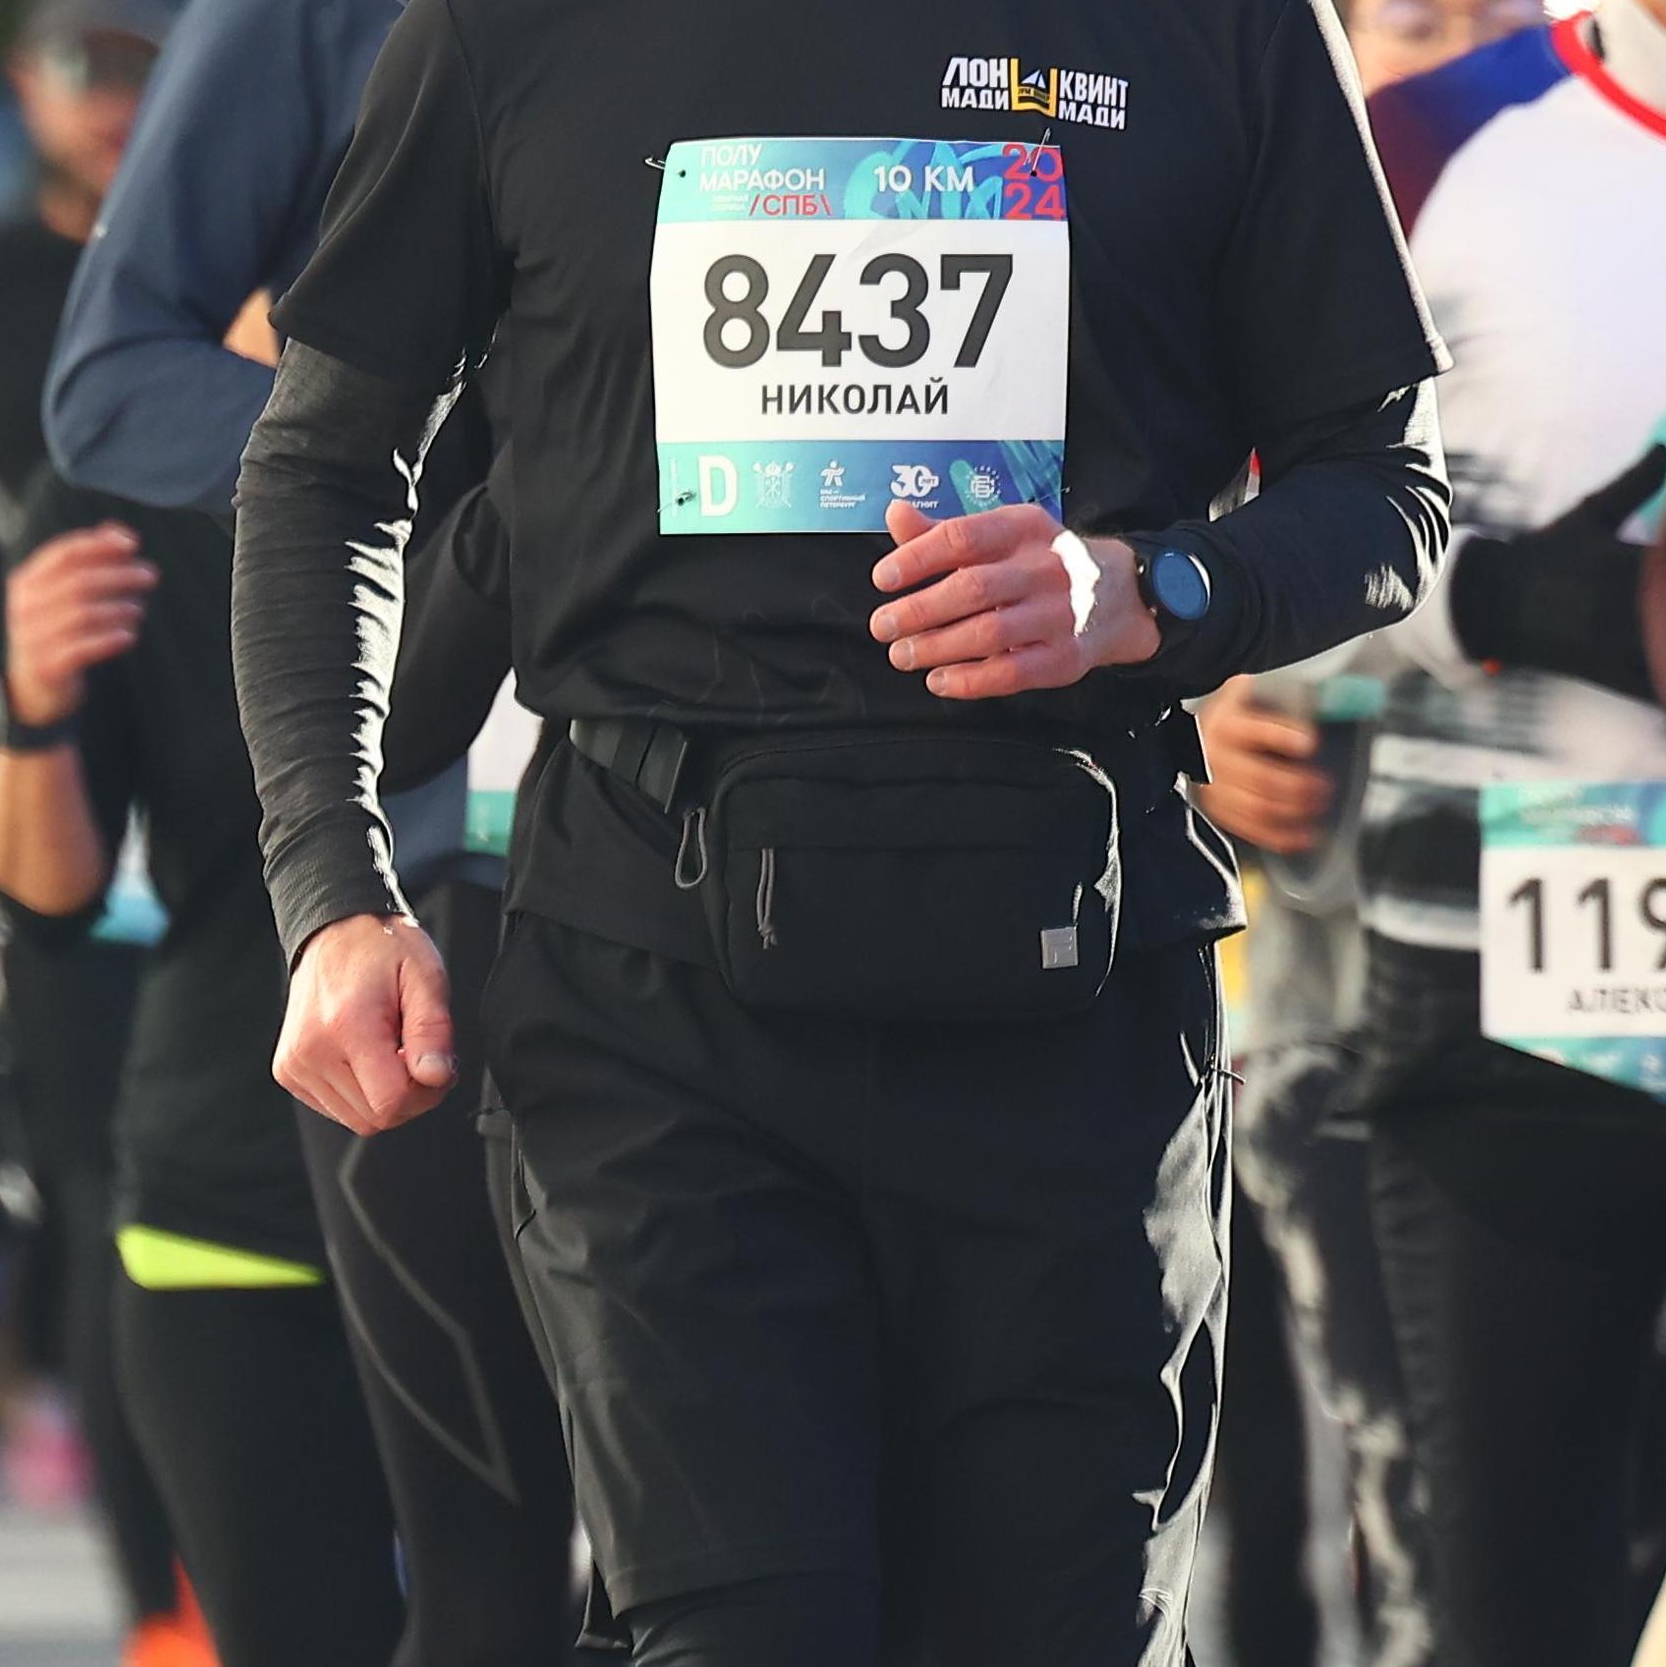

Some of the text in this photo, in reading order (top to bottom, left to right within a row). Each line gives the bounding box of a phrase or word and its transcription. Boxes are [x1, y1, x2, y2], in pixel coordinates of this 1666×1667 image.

[942, 57, 1008, 88] ЛОН
[1060, 69, 1130, 108] КВИНТ
[941, 88, 1009, 111] МАДИ
[1058, 100, 1126, 130] МАДИ
[700, 143, 763, 167] ПОЛУ
[1002, 142, 1064, 182] 20
[699, 168, 825, 192] МАРАФОН
[874, 165, 975, 192] 10 КМ
[1004, 183, 1065, 220] 24
[702, 252, 1014, 369] 8437
[760, 377, 950, 415] НИКОЛАЙ
[698, 454, 738, 517] D
